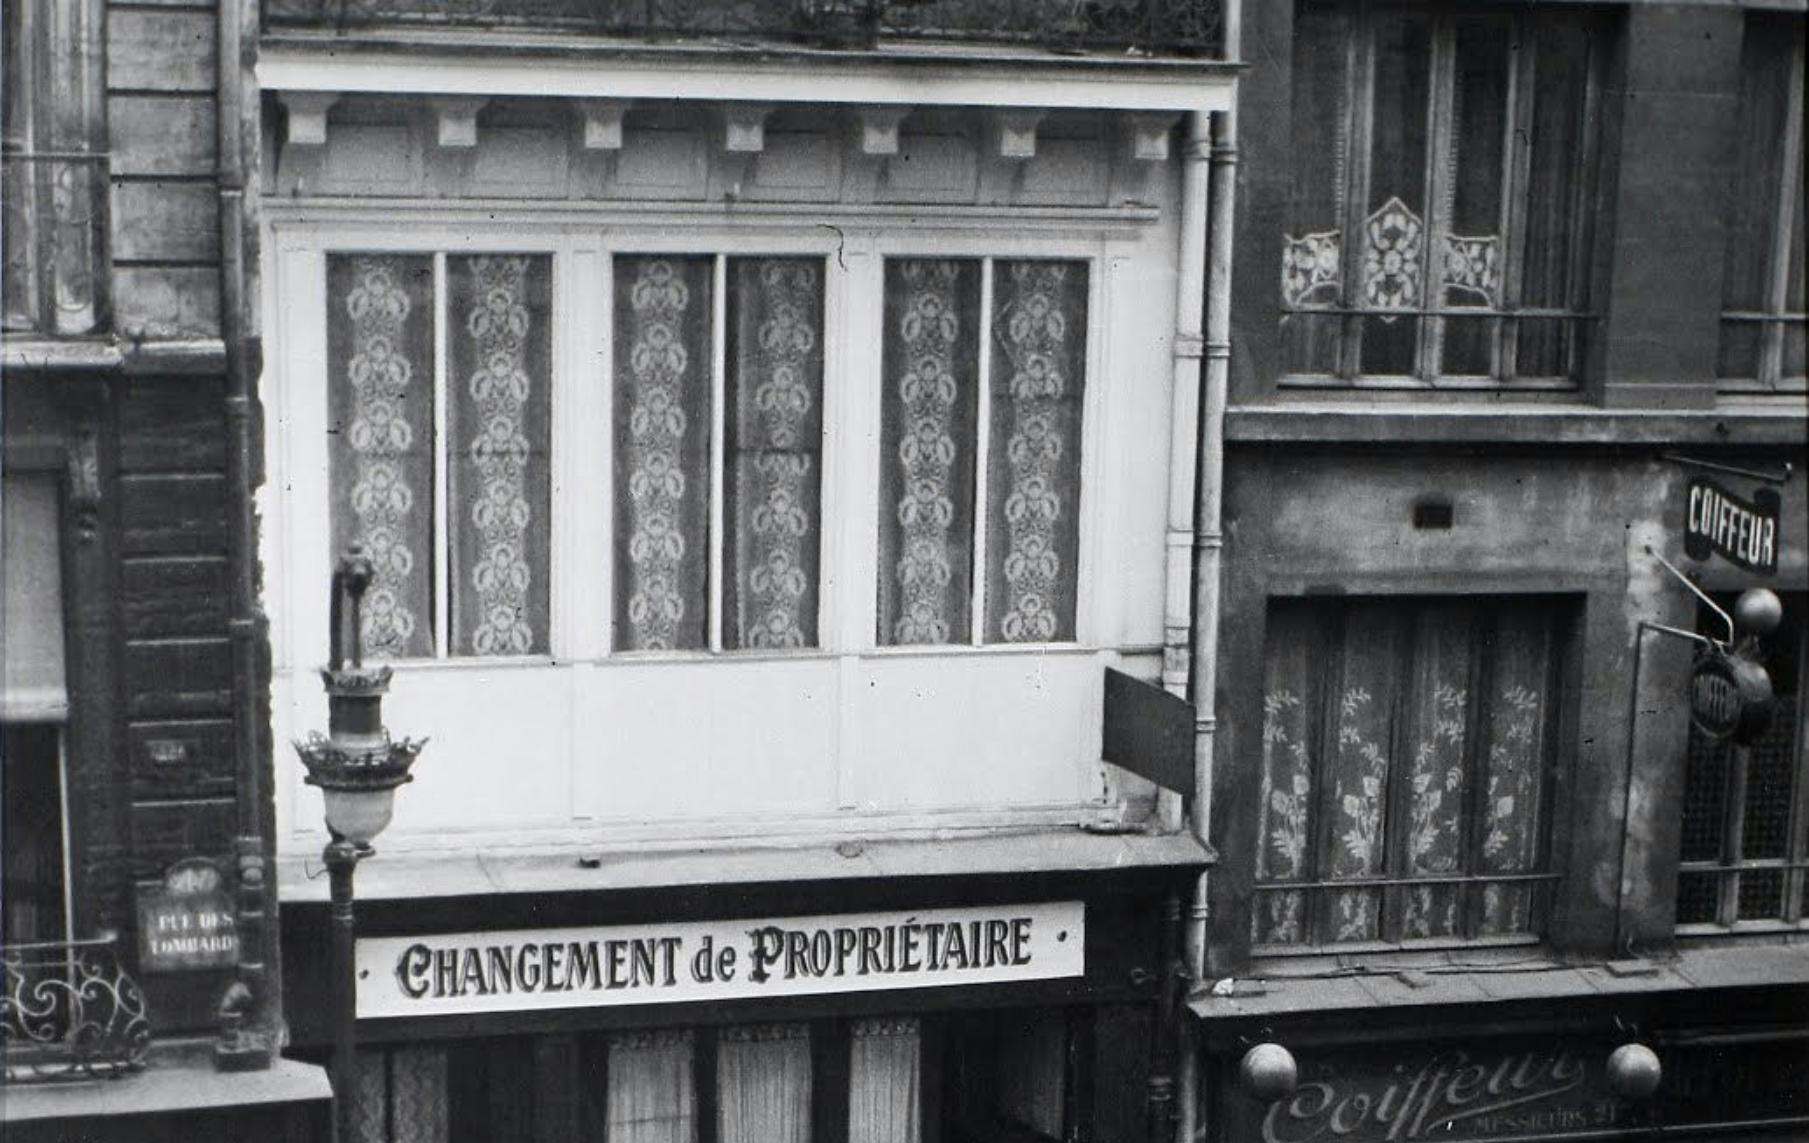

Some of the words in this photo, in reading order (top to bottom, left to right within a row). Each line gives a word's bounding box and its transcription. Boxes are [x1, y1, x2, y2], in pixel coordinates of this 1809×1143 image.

[1689, 486, 1774, 566] COIFFEUR
[398, 936, 684, 999] CHANGEMENT
[691, 937, 737, 982] de
[747, 916, 1034, 984] PROPRIÉTAIRE
